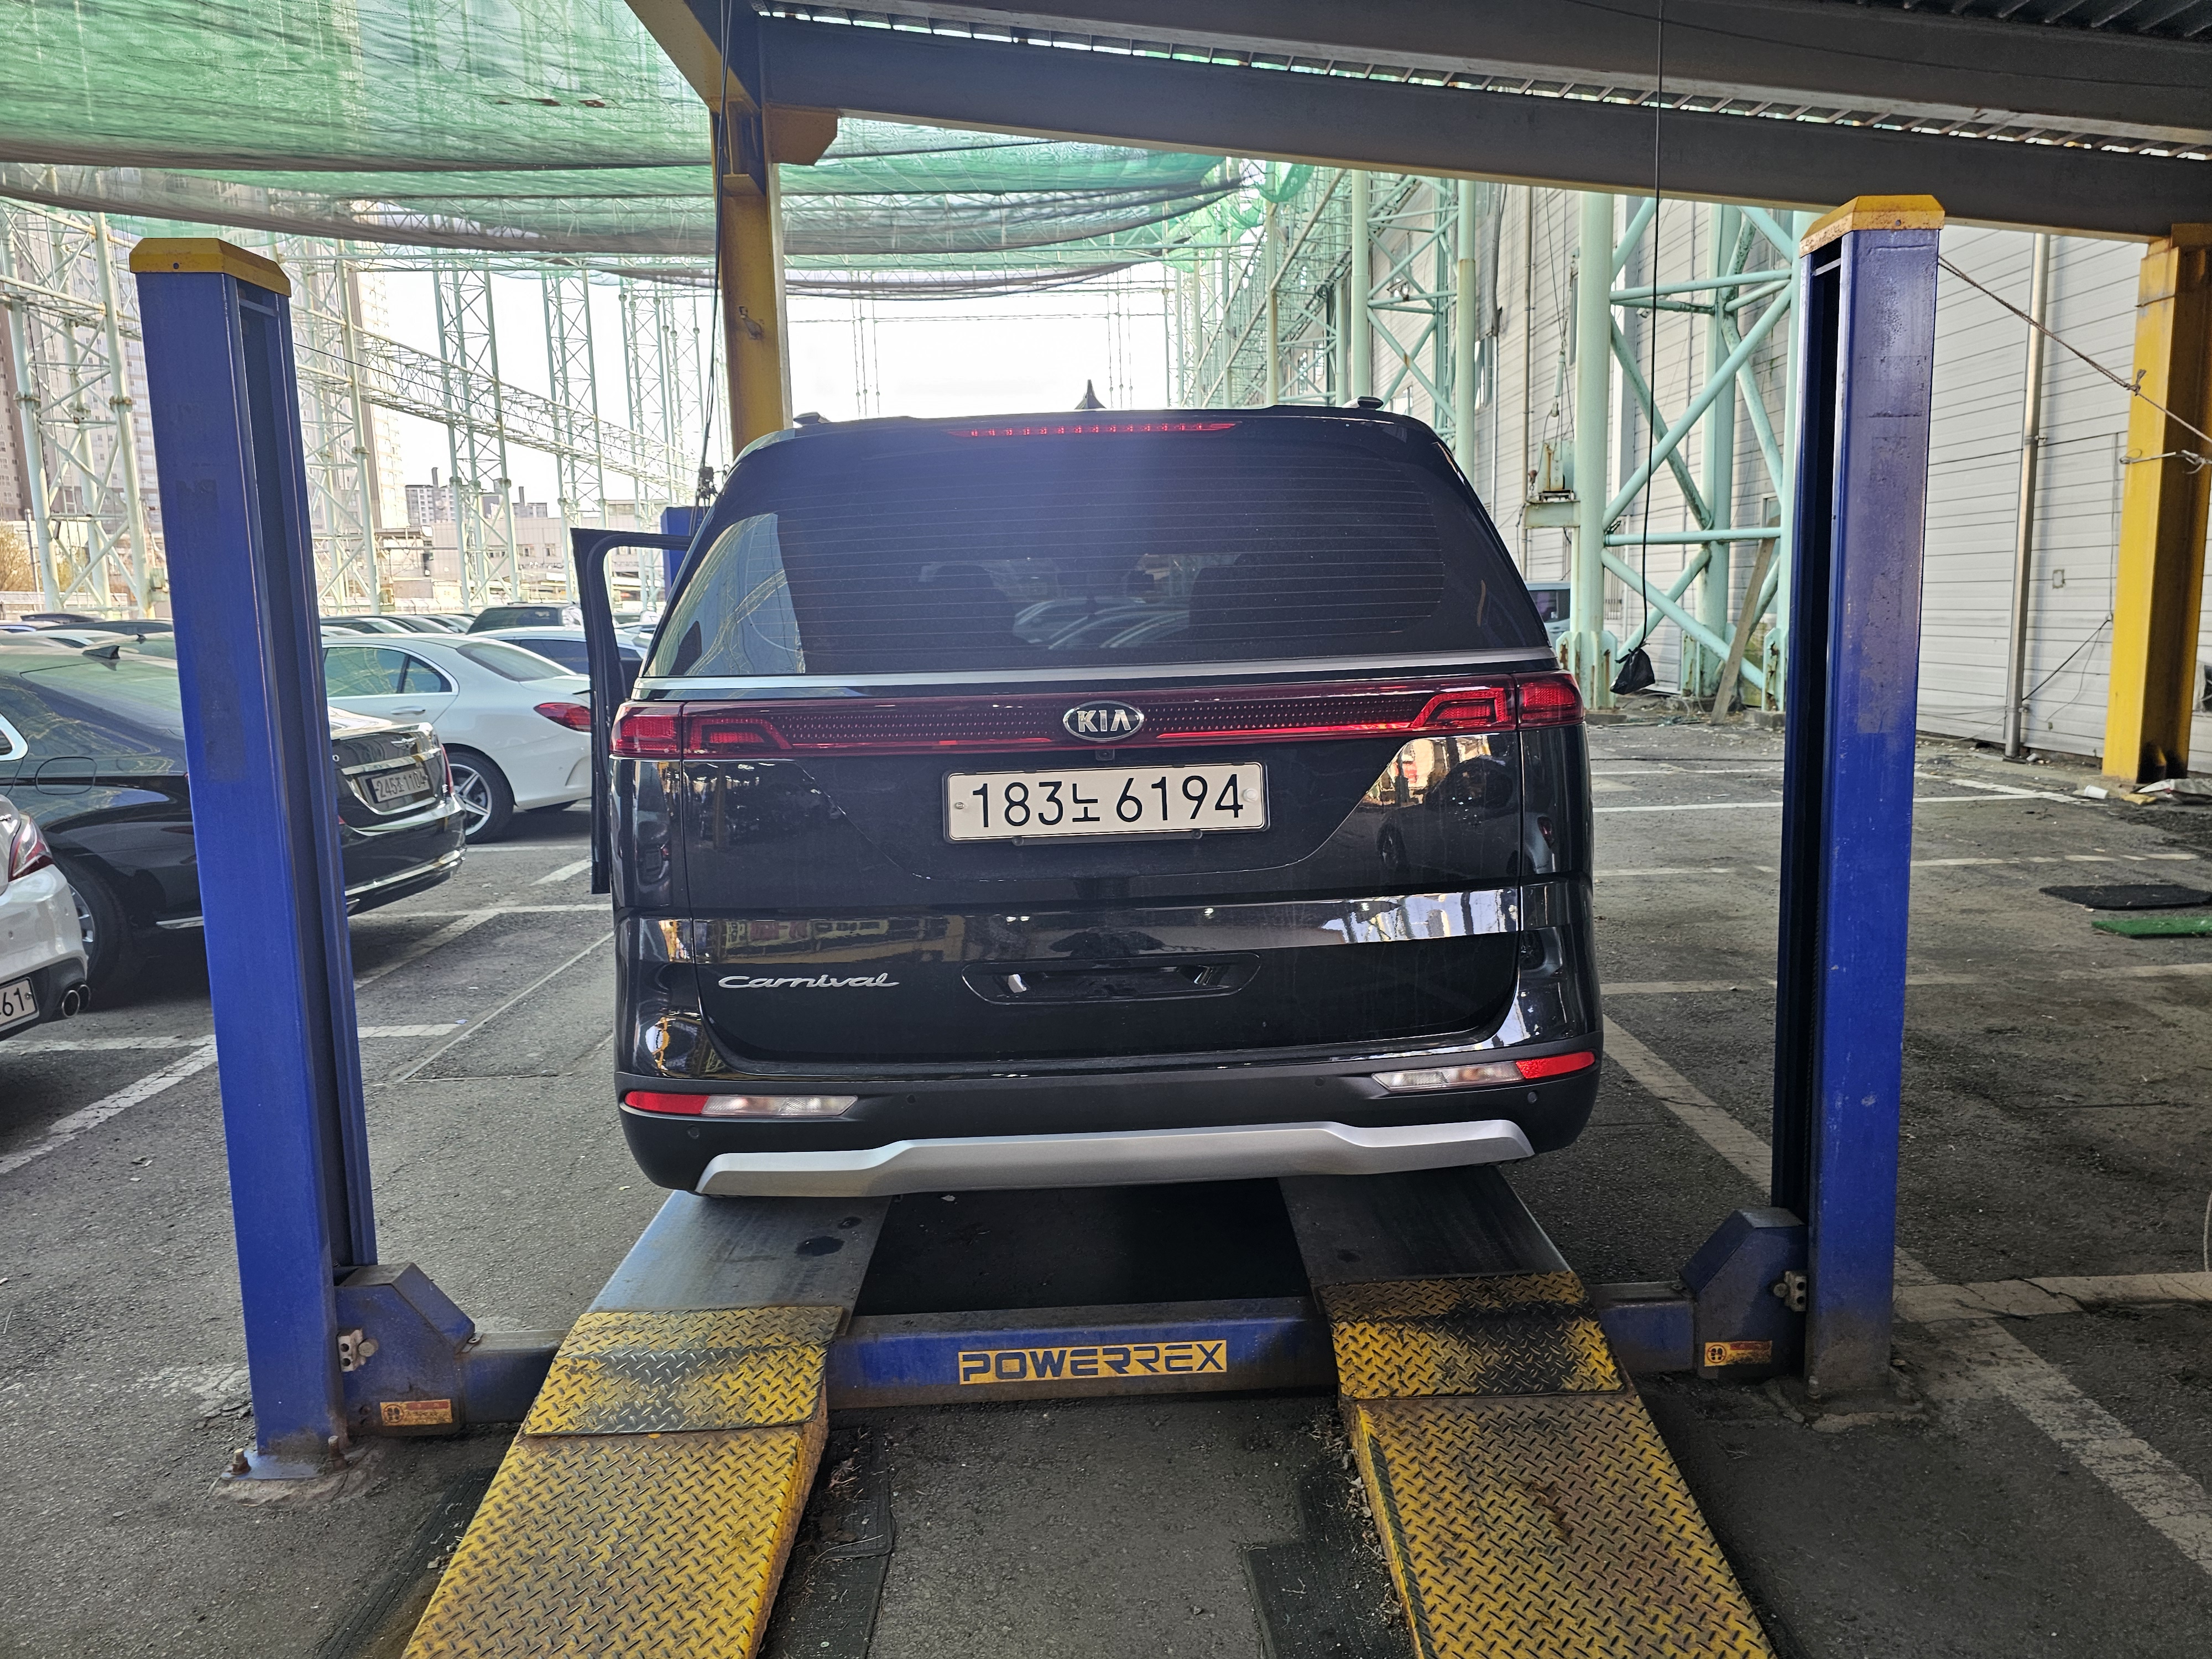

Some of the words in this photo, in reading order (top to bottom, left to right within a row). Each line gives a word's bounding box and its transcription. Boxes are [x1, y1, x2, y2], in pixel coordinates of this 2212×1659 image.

[1077, 709, 1131, 733] KIA
[1115, 774, 1244, 823] 6194
[718, 972, 900, 989] Carnival
[0, 987, 25, 1017] 61
[962, 1343, 1224, 1381] POWERREX
